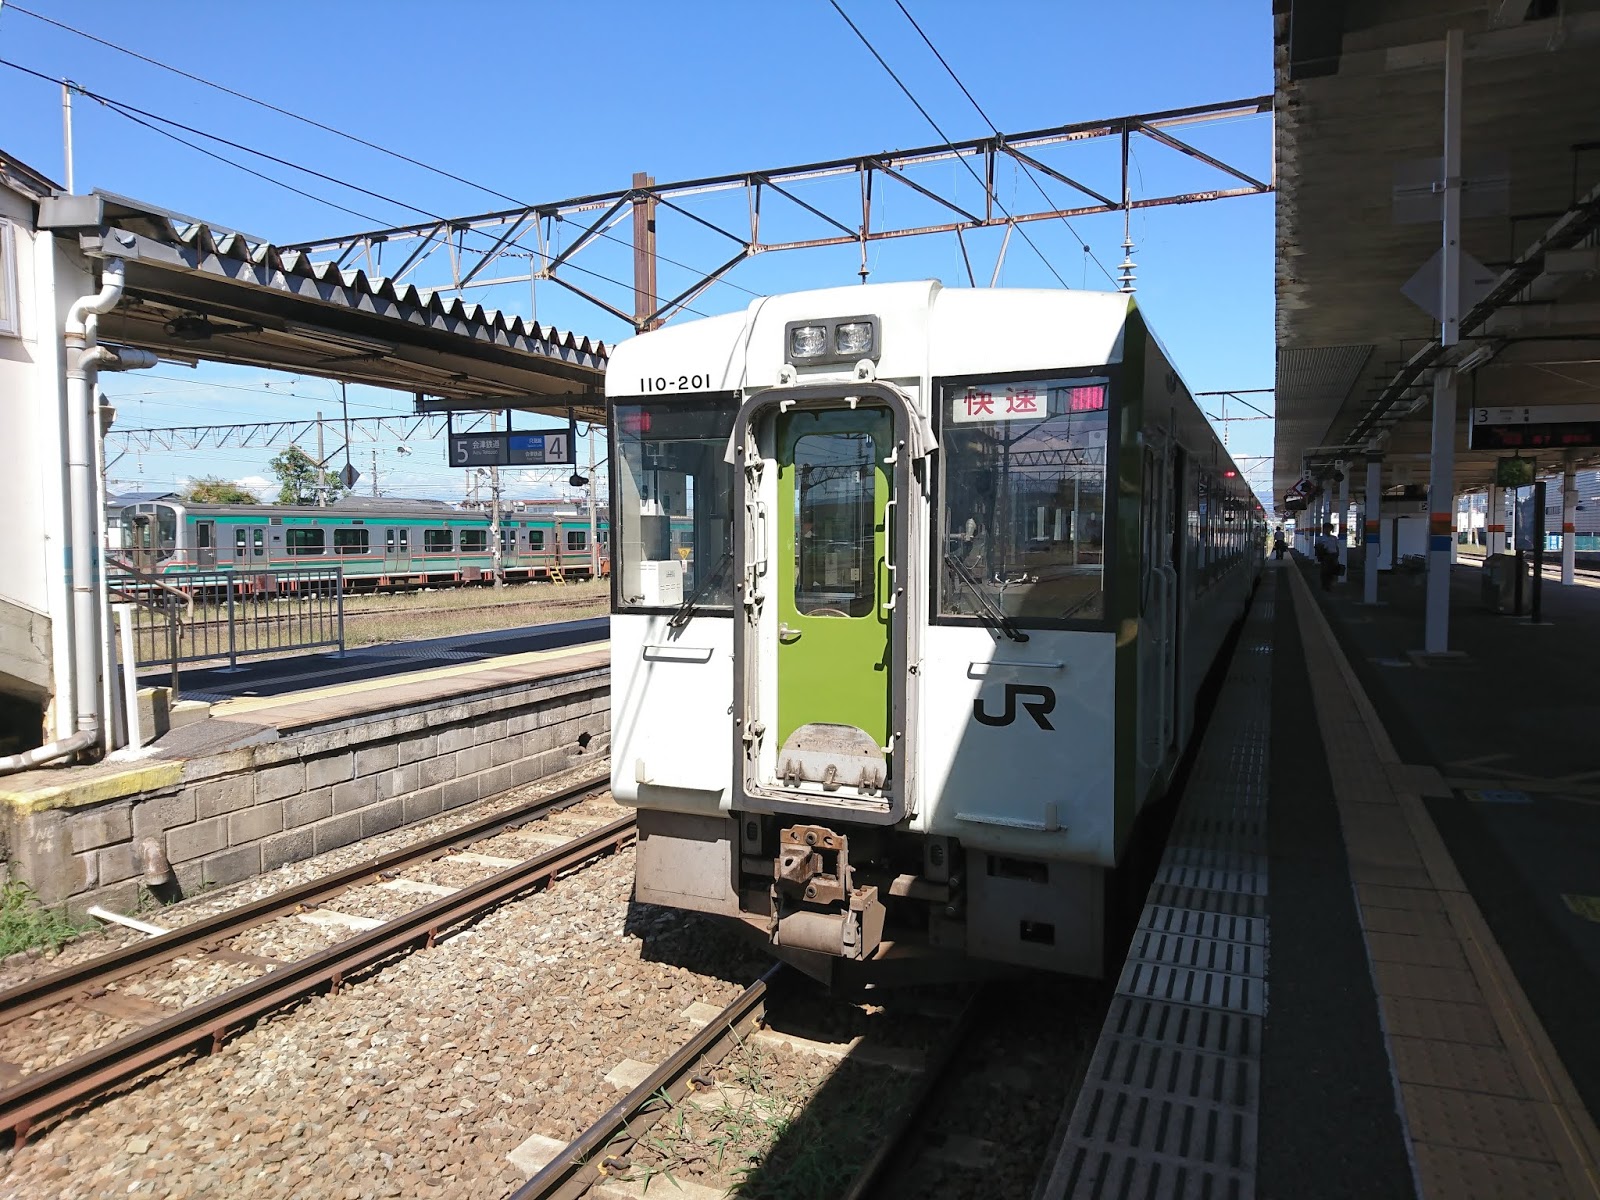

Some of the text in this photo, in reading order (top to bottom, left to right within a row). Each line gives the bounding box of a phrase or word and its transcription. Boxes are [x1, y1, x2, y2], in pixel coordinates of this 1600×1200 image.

[640, 374, 710, 393] 110-201
[963, 386, 1038, 416] 快速
[1478, 409, 1489, 423] 3
[457, 440, 469, 464] 5
[472, 439, 500, 449] 会津鉄道
[549, 437, 563, 460] 4
[973, 683, 1056, 731] JR
